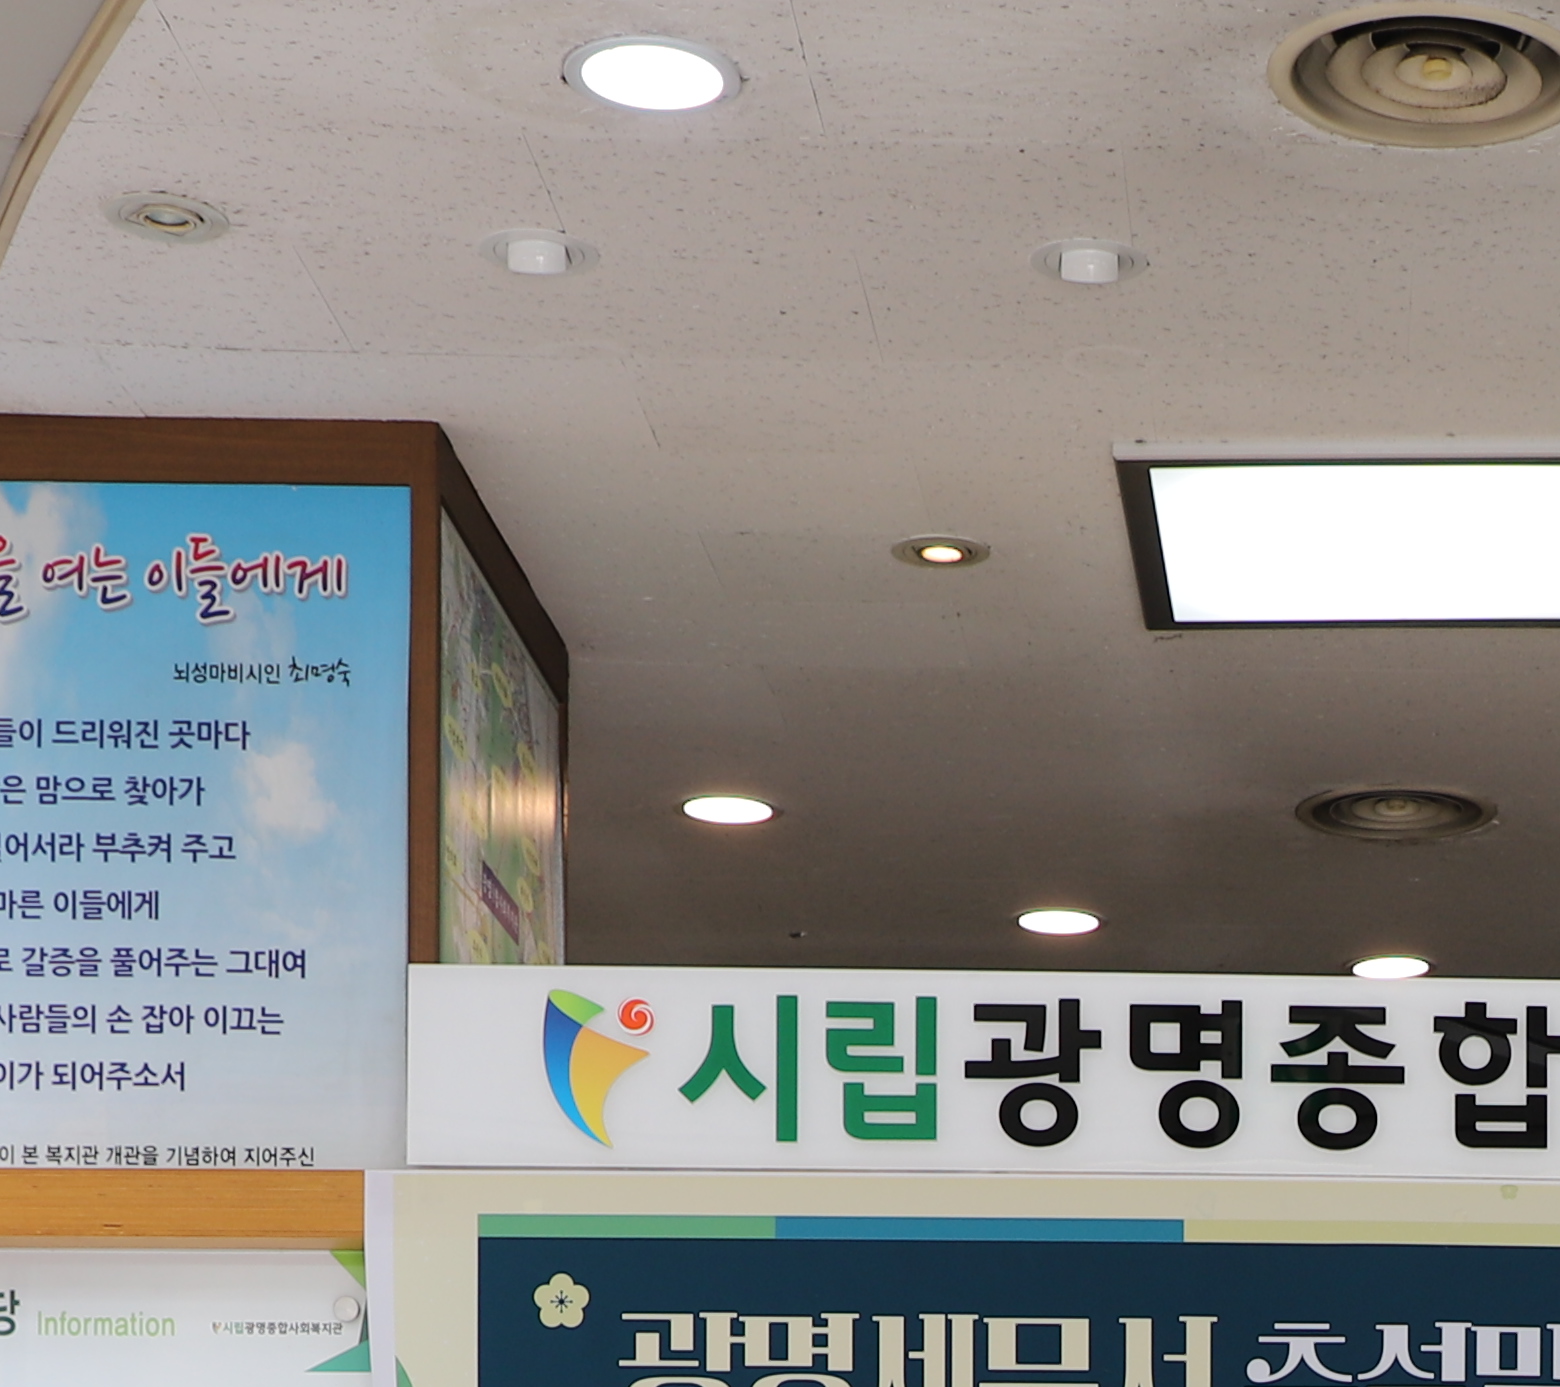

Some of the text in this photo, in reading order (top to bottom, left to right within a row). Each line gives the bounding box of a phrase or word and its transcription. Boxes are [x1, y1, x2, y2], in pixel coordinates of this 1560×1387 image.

[40, 544, 132, 610] 여는
[146, 531, 350, 626] 이들에게
[173, 662, 281, 685] 뇌성마비시인
[52, 719, 159, 750] 드리워진
[168, 719, 251, 751] 곳마다
[35, 775, 116, 805] 맘으로
[124, 775, 206, 807] 찾아가
[22, 946, 102, 978] 갈증을
[110, 947, 219, 978] 풀어주는
[226, 948, 306, 980] 그대여
[22, 1145, 39, 1166] 본
[46, 1145, 99, 1166] 복지관
[107, 1145, 159, 1167] 개관을
[167, 1146, 237, 1167] 기념하여
[244, 1146, 314, 1168] 지어주신
[34, 1310, 175, 1337] Information
